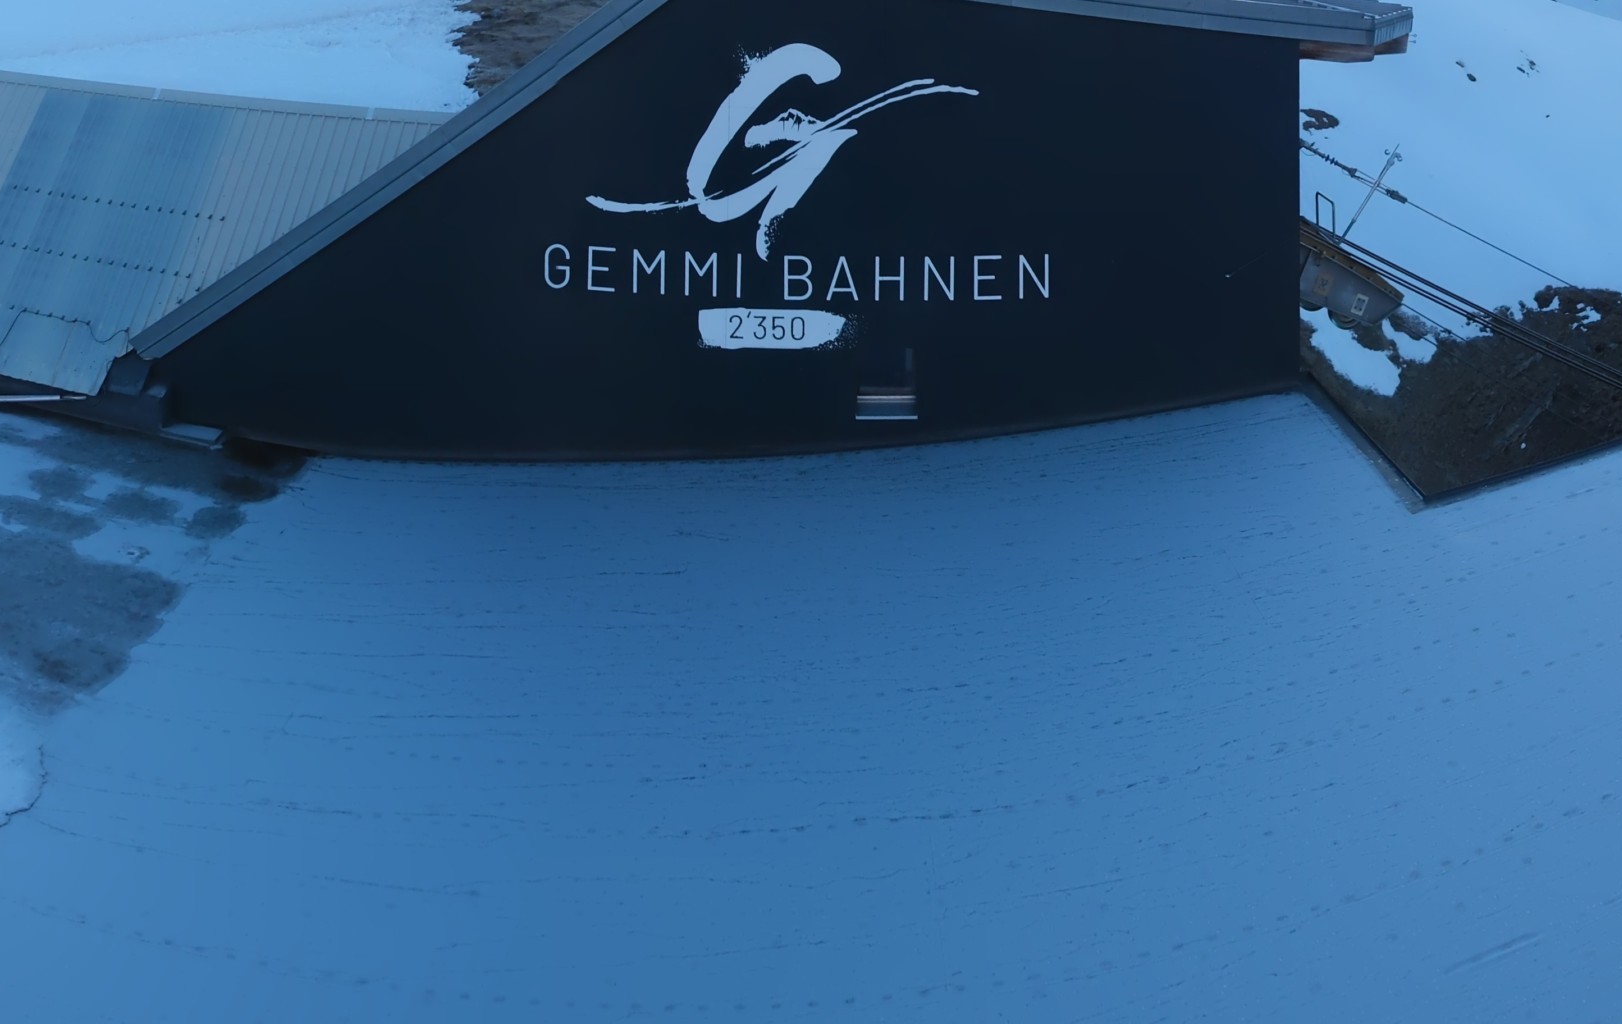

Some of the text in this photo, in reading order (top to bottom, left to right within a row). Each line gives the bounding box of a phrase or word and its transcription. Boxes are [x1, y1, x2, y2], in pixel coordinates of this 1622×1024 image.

[544, 243, 1051, 302] GEMMI BAHNEN
[729, 311, 805, 340] 2'350
